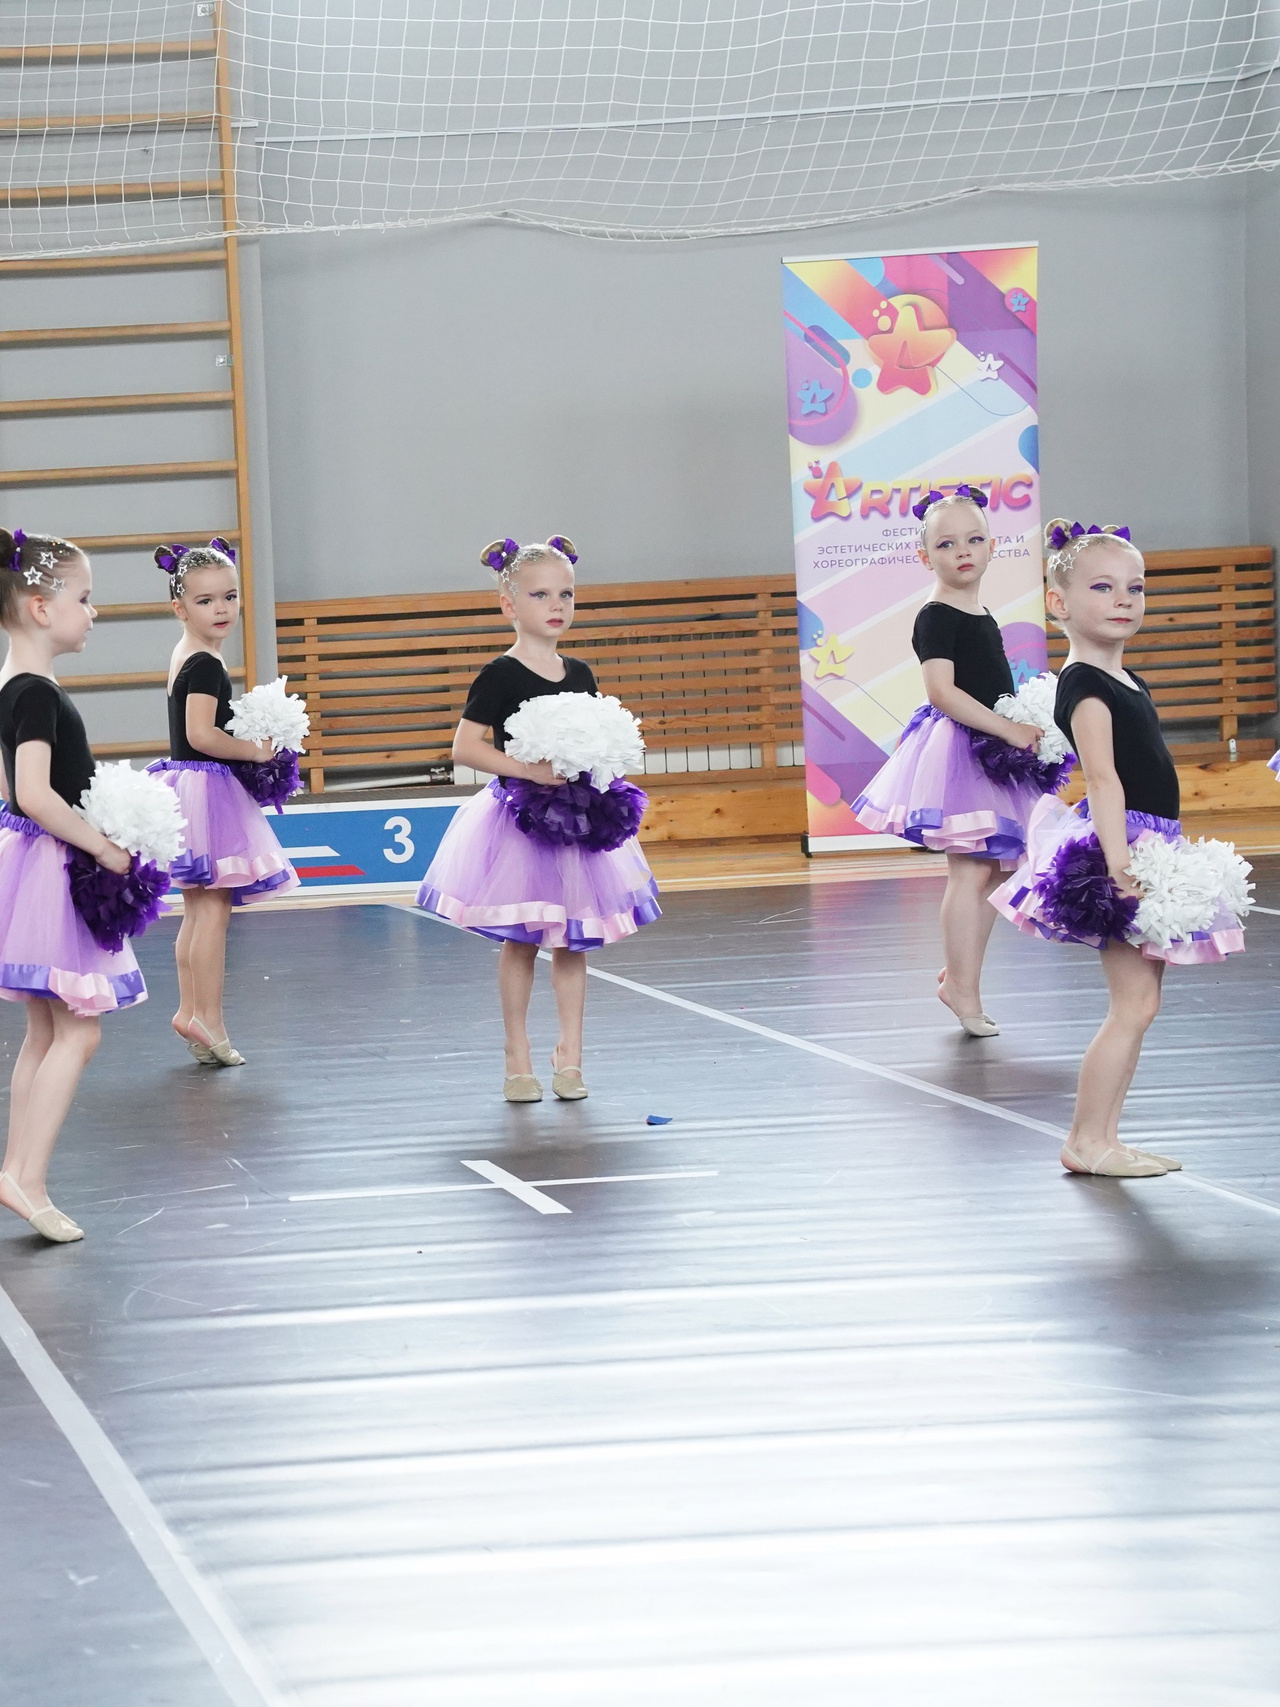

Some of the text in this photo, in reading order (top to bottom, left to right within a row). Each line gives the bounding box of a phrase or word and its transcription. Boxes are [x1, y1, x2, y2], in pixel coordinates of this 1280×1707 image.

[882, 527, 922, 537] ФЕСТИ
[817, 541, 912, 555] ЭСТЕТИЧЕСКИХ
[813, 554, 920, 569] ХОРЕОГРАФИЧЕС
[383, 815, 415, 864] 3
